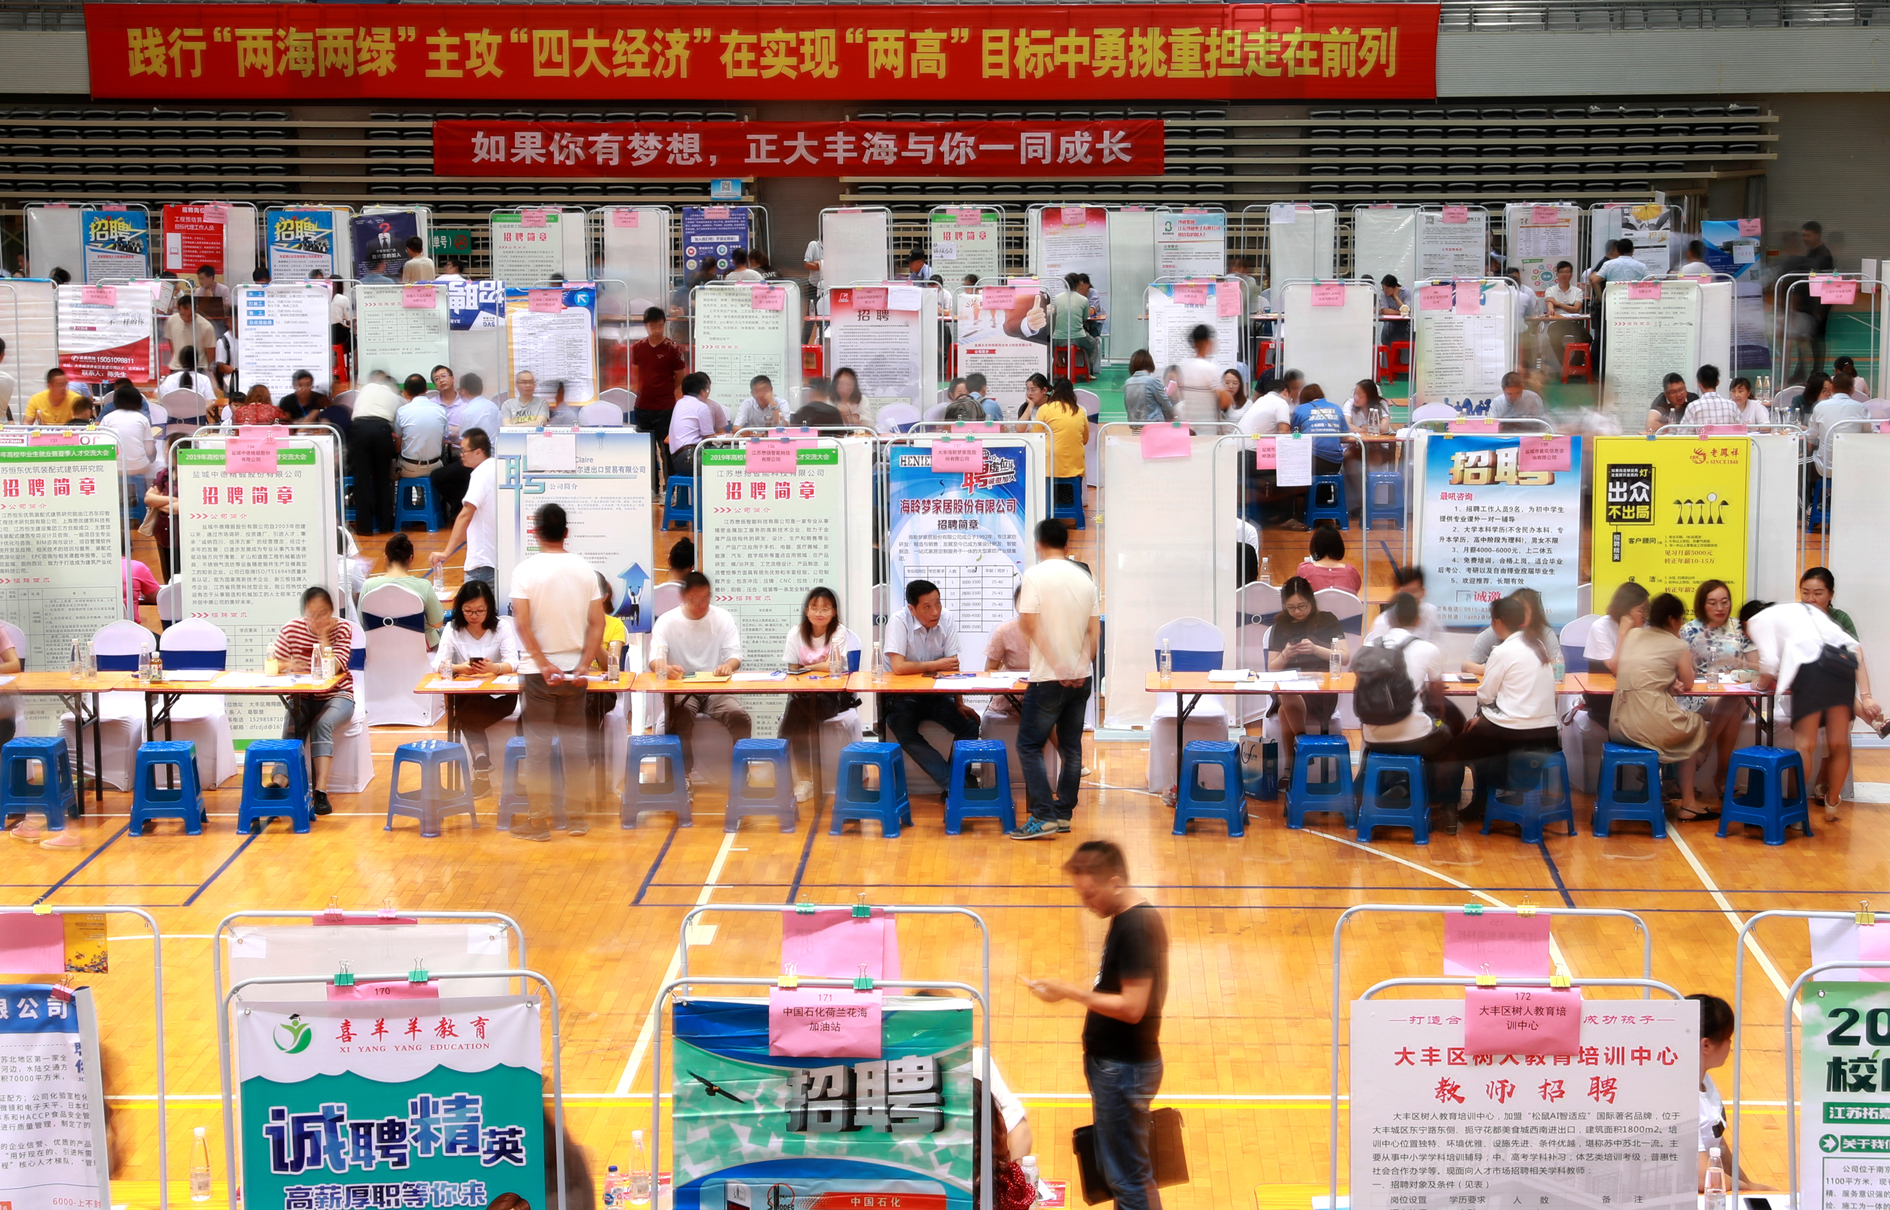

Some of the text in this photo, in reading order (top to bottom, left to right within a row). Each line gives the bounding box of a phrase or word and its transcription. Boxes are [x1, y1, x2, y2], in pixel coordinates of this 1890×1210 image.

[470, 129, 1132, 166] 如果你有梦想，正大丰海与你一同成长
[89, 219, 130, 242] 招聘
[274, 221, 316, 242] 招聘
[857, 310, 890, 321] 招聘
[1449, 447, 1555, 485] 招聘
[1639, 468, 1648, 477] 灯
[3, 477, 96, 497] 招聘简章
[726, 481, 815, 500] 招聘简章
[1608, 481, 1650, 502] 出众
[202, 486, 293, 505] 招聘简章
[1439, 492, 1473, 501] 最吼咨询
[899, 498, 1017, 514] 海聆梦家居股份有限公司
[1608, 505, 1650, 520] 不出局
[937, 519, 979, 530] 招聘简章
[1439, 515, 1515, 523] 提供专业课外一对一辅导
[375, 987, 391, 996] 170
[818, 994, 833, 1002] 171
[1515, 992, 1531, 1000] 172
[782, 1006, 868, 1019] 中国石化荷兰花海
[1479, 1006, 1567, 1017] 大丰区树人教育培
[335, 1015, 490, 1043] 喜羊羊教育
[809, 1021, 841, 1033] 加油站
[1506, 1020, 1539, 1031] 训中心
[339, 1042, 490, 1054] XI YANG YANG EDUCATION
[1, 1054, 67, 1063] 苏北地区第一家全
[1394, 1046, 1679, 1067] 大丰区树人教育培训中心
[1, 1064, 68, 1073] 河边，水陆交通方
[1826, 1055, 1890, 1093] 校
[786, 1055, 945, 1133] 招聘
[1434, 1076, 1618, 1104] 教师招聘
[264, 1093, 526, 1174] 诚聘精英
[284, 1180, 487, 1210] 高薪厚职等你来
[850, 1197, 901, 1207] 中国石化
[1390, 1195, 1427, 1204] 岗位设置
[1449, 1195, 1486, 1204] 学历要求
